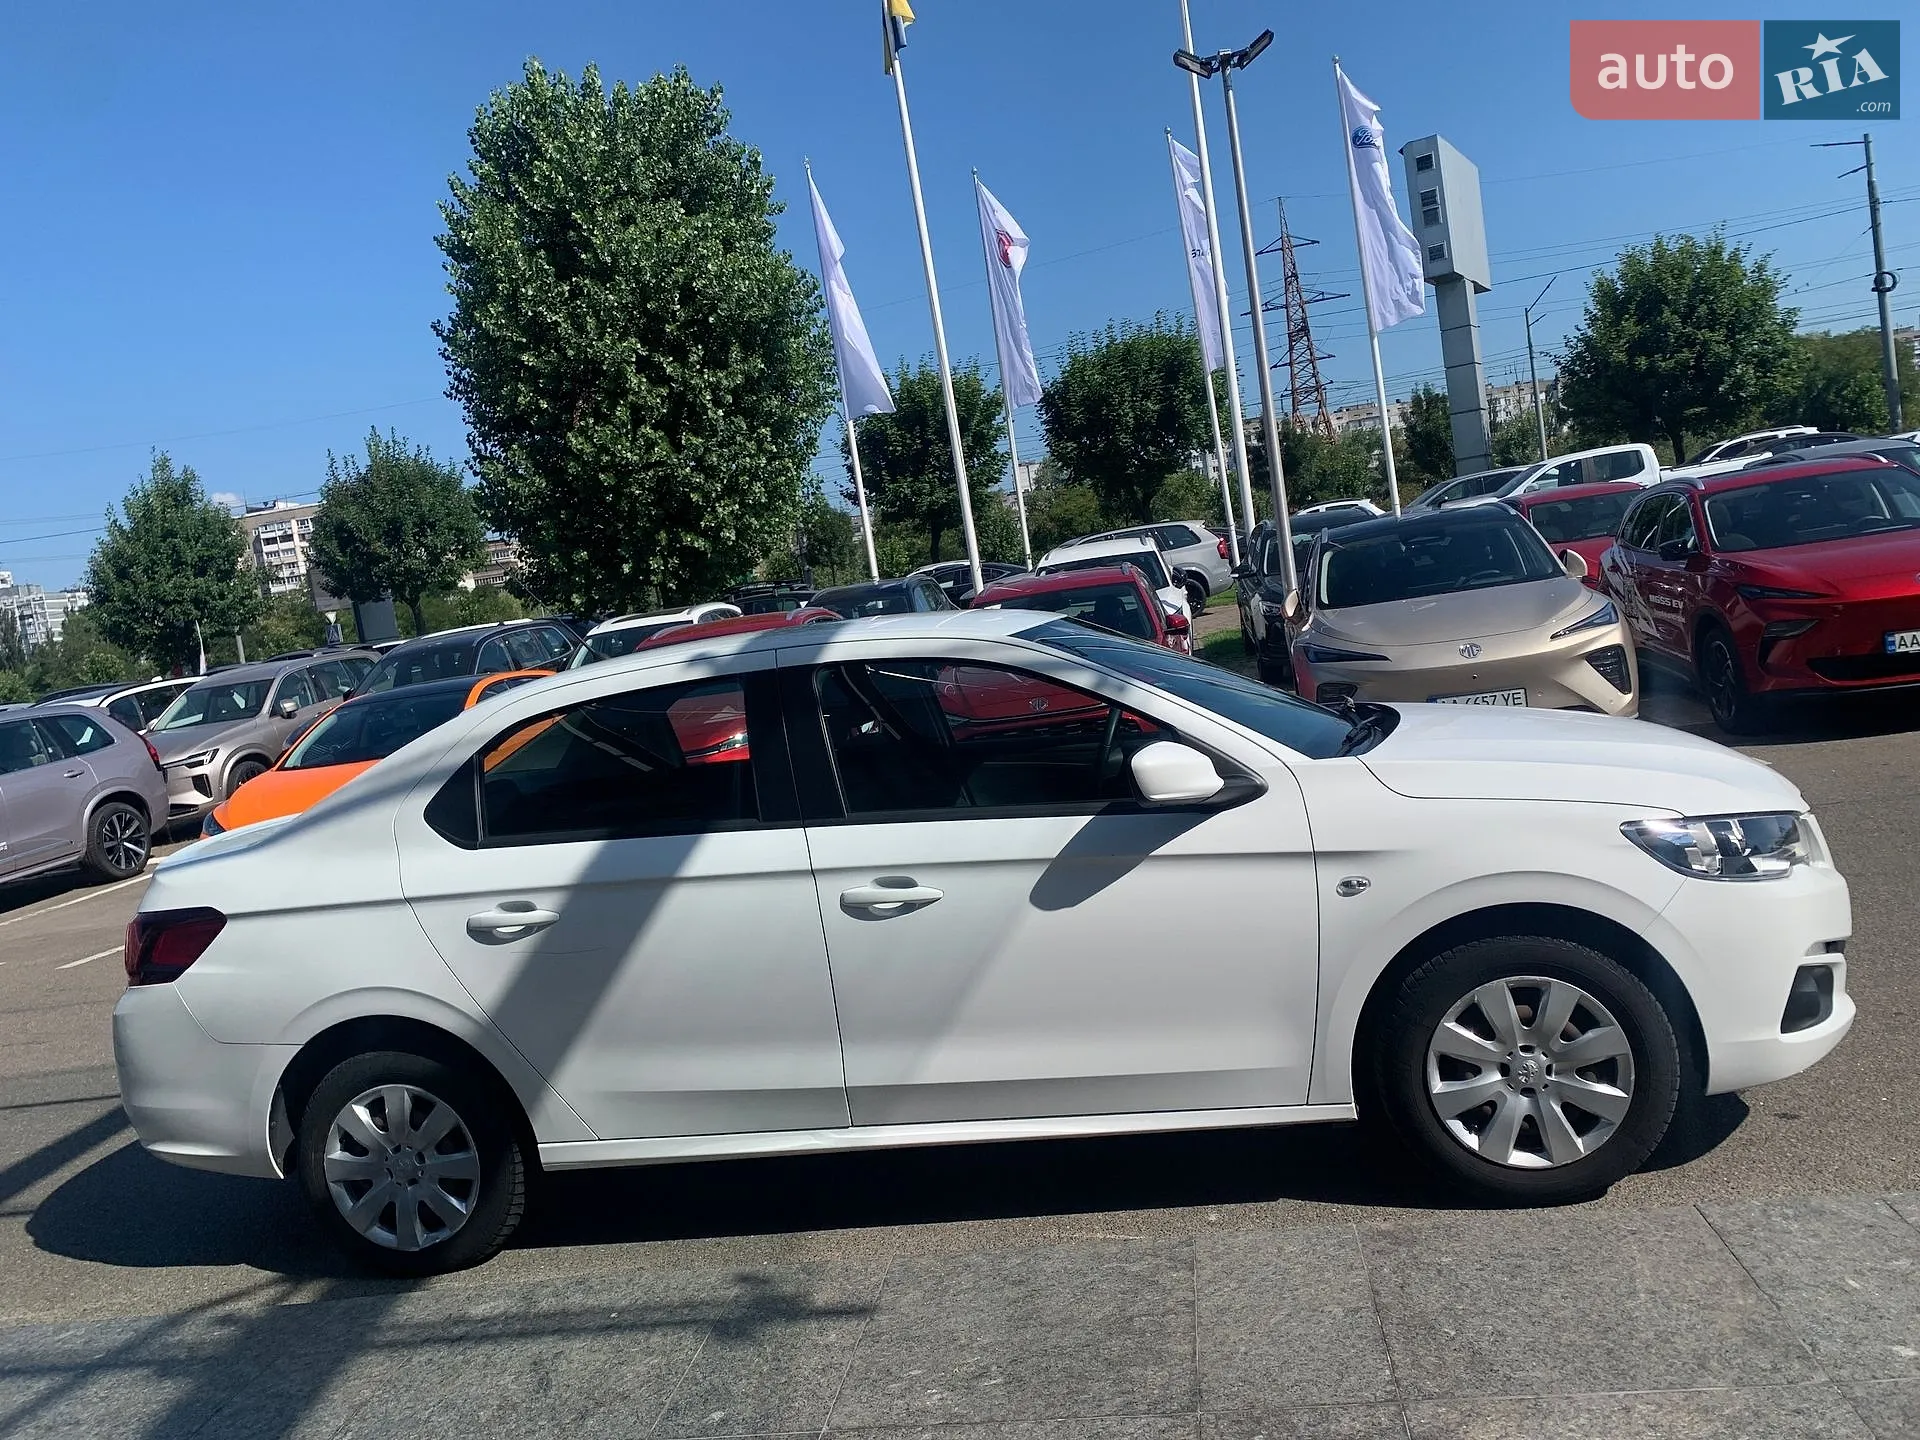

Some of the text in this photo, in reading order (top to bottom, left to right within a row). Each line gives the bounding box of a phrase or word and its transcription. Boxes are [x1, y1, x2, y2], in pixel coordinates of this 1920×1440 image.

[1898, 635, 1920, 649] AA
[1460, 643, 1481, 659] MG
[1502, 692, 1522, 706] YE
